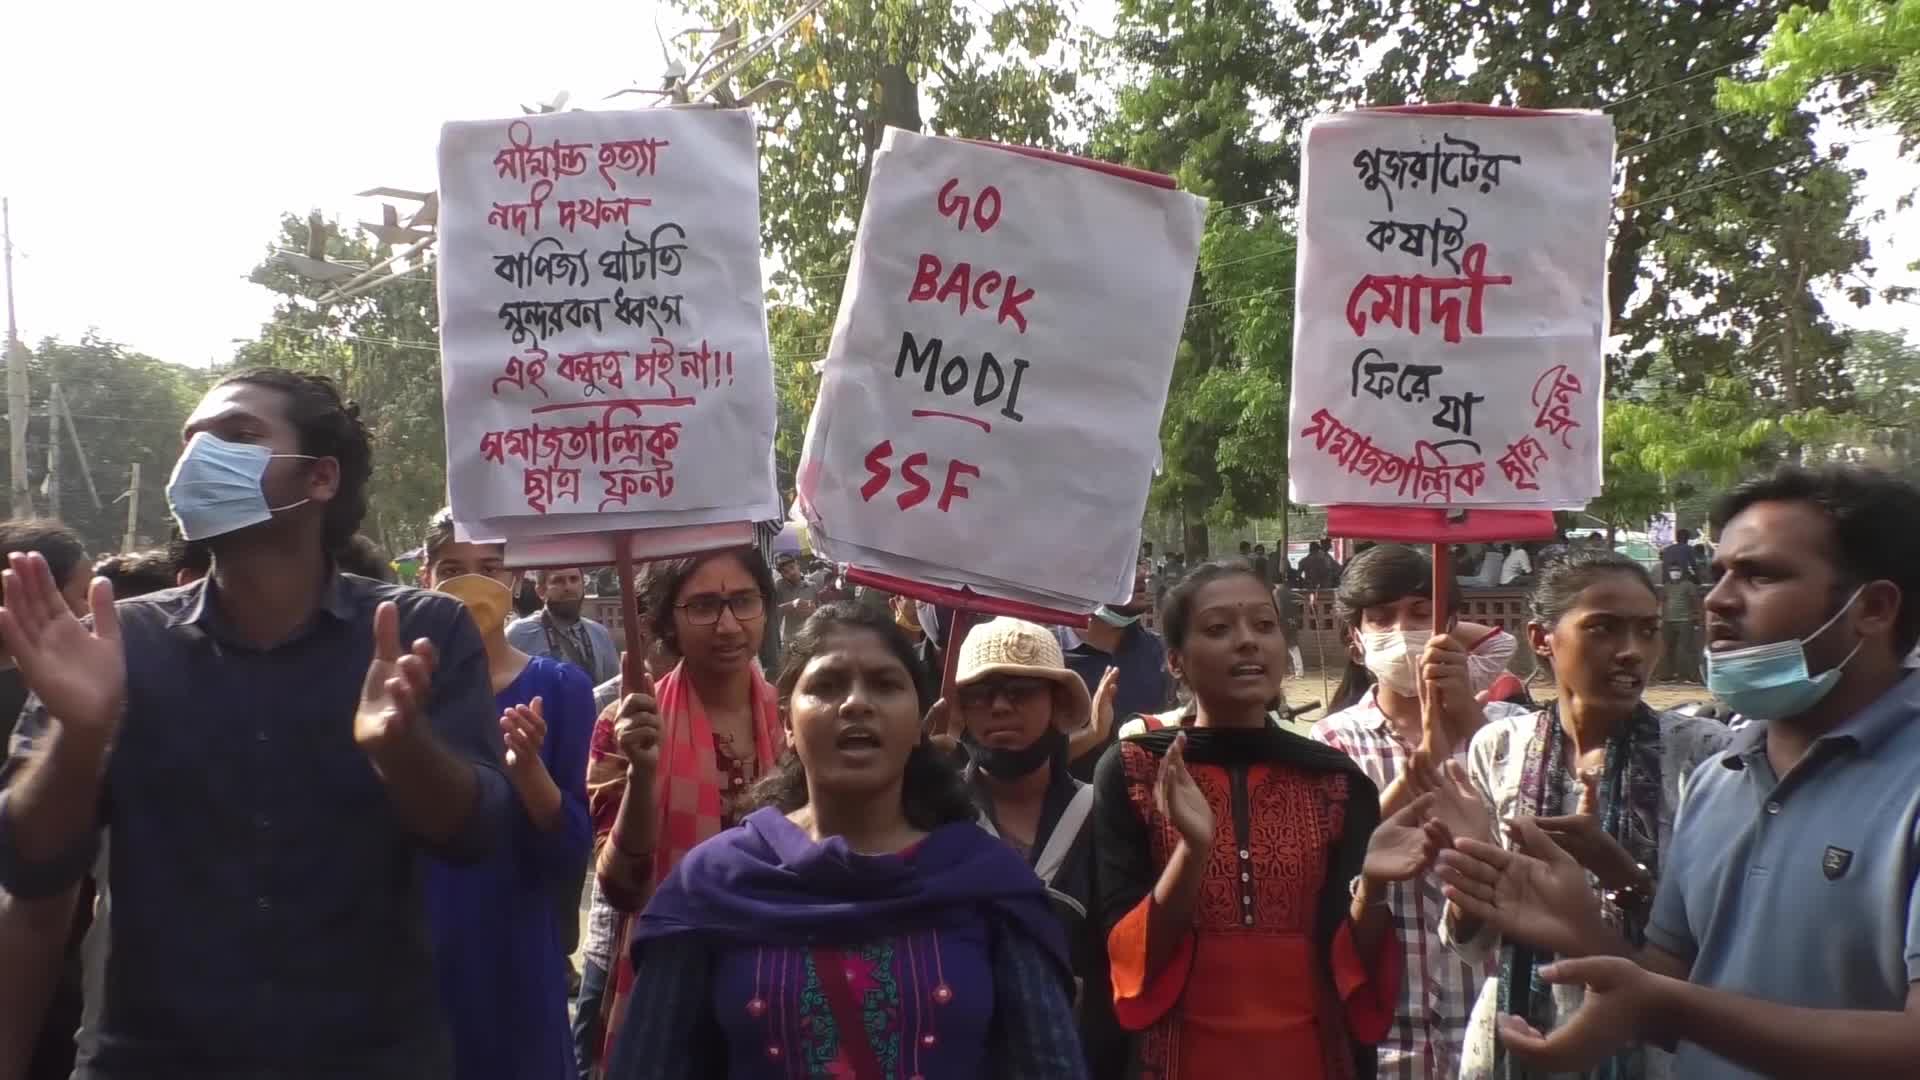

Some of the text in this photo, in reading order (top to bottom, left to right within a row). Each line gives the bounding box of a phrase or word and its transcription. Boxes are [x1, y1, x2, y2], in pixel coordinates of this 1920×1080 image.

[494, 120, 669, 191] সীমান্ত হত্যা
[1353, 132, 1521, 212] গুজরাটের
[488, 179, 652, 236] নদী দখল
[937, 177, 1001, 232] GO
[493, 222, 688, 288] বাণিজ্য ঘাটতি
[499, 286, 683, 349] সুন্দরবন ধ্বংস
[907, 253, 1036, 334] BACK
[1345, 242, 1513, 344] মোদী
[492, 348, 548, 398] এই
[557, 351, 630, 397] বন্ধুত্ব
[635, 337, 676, 397] চাই
[894, 331, 1030, 423] MODI
[1351, 348, 1443, 403] ফিরে
[480, 403, 682, 467] সমাজতান্ত্রিক
[1301, 364, 1582, 503] সমাজতান্ত্রিক ছাত্র ফ্রন্ট
[1432, 391, 1485, 436] যা
[523, 460, 674, 513] ছাত্র ফ্রন্ট
[860, 439, 981, 513] SSF
